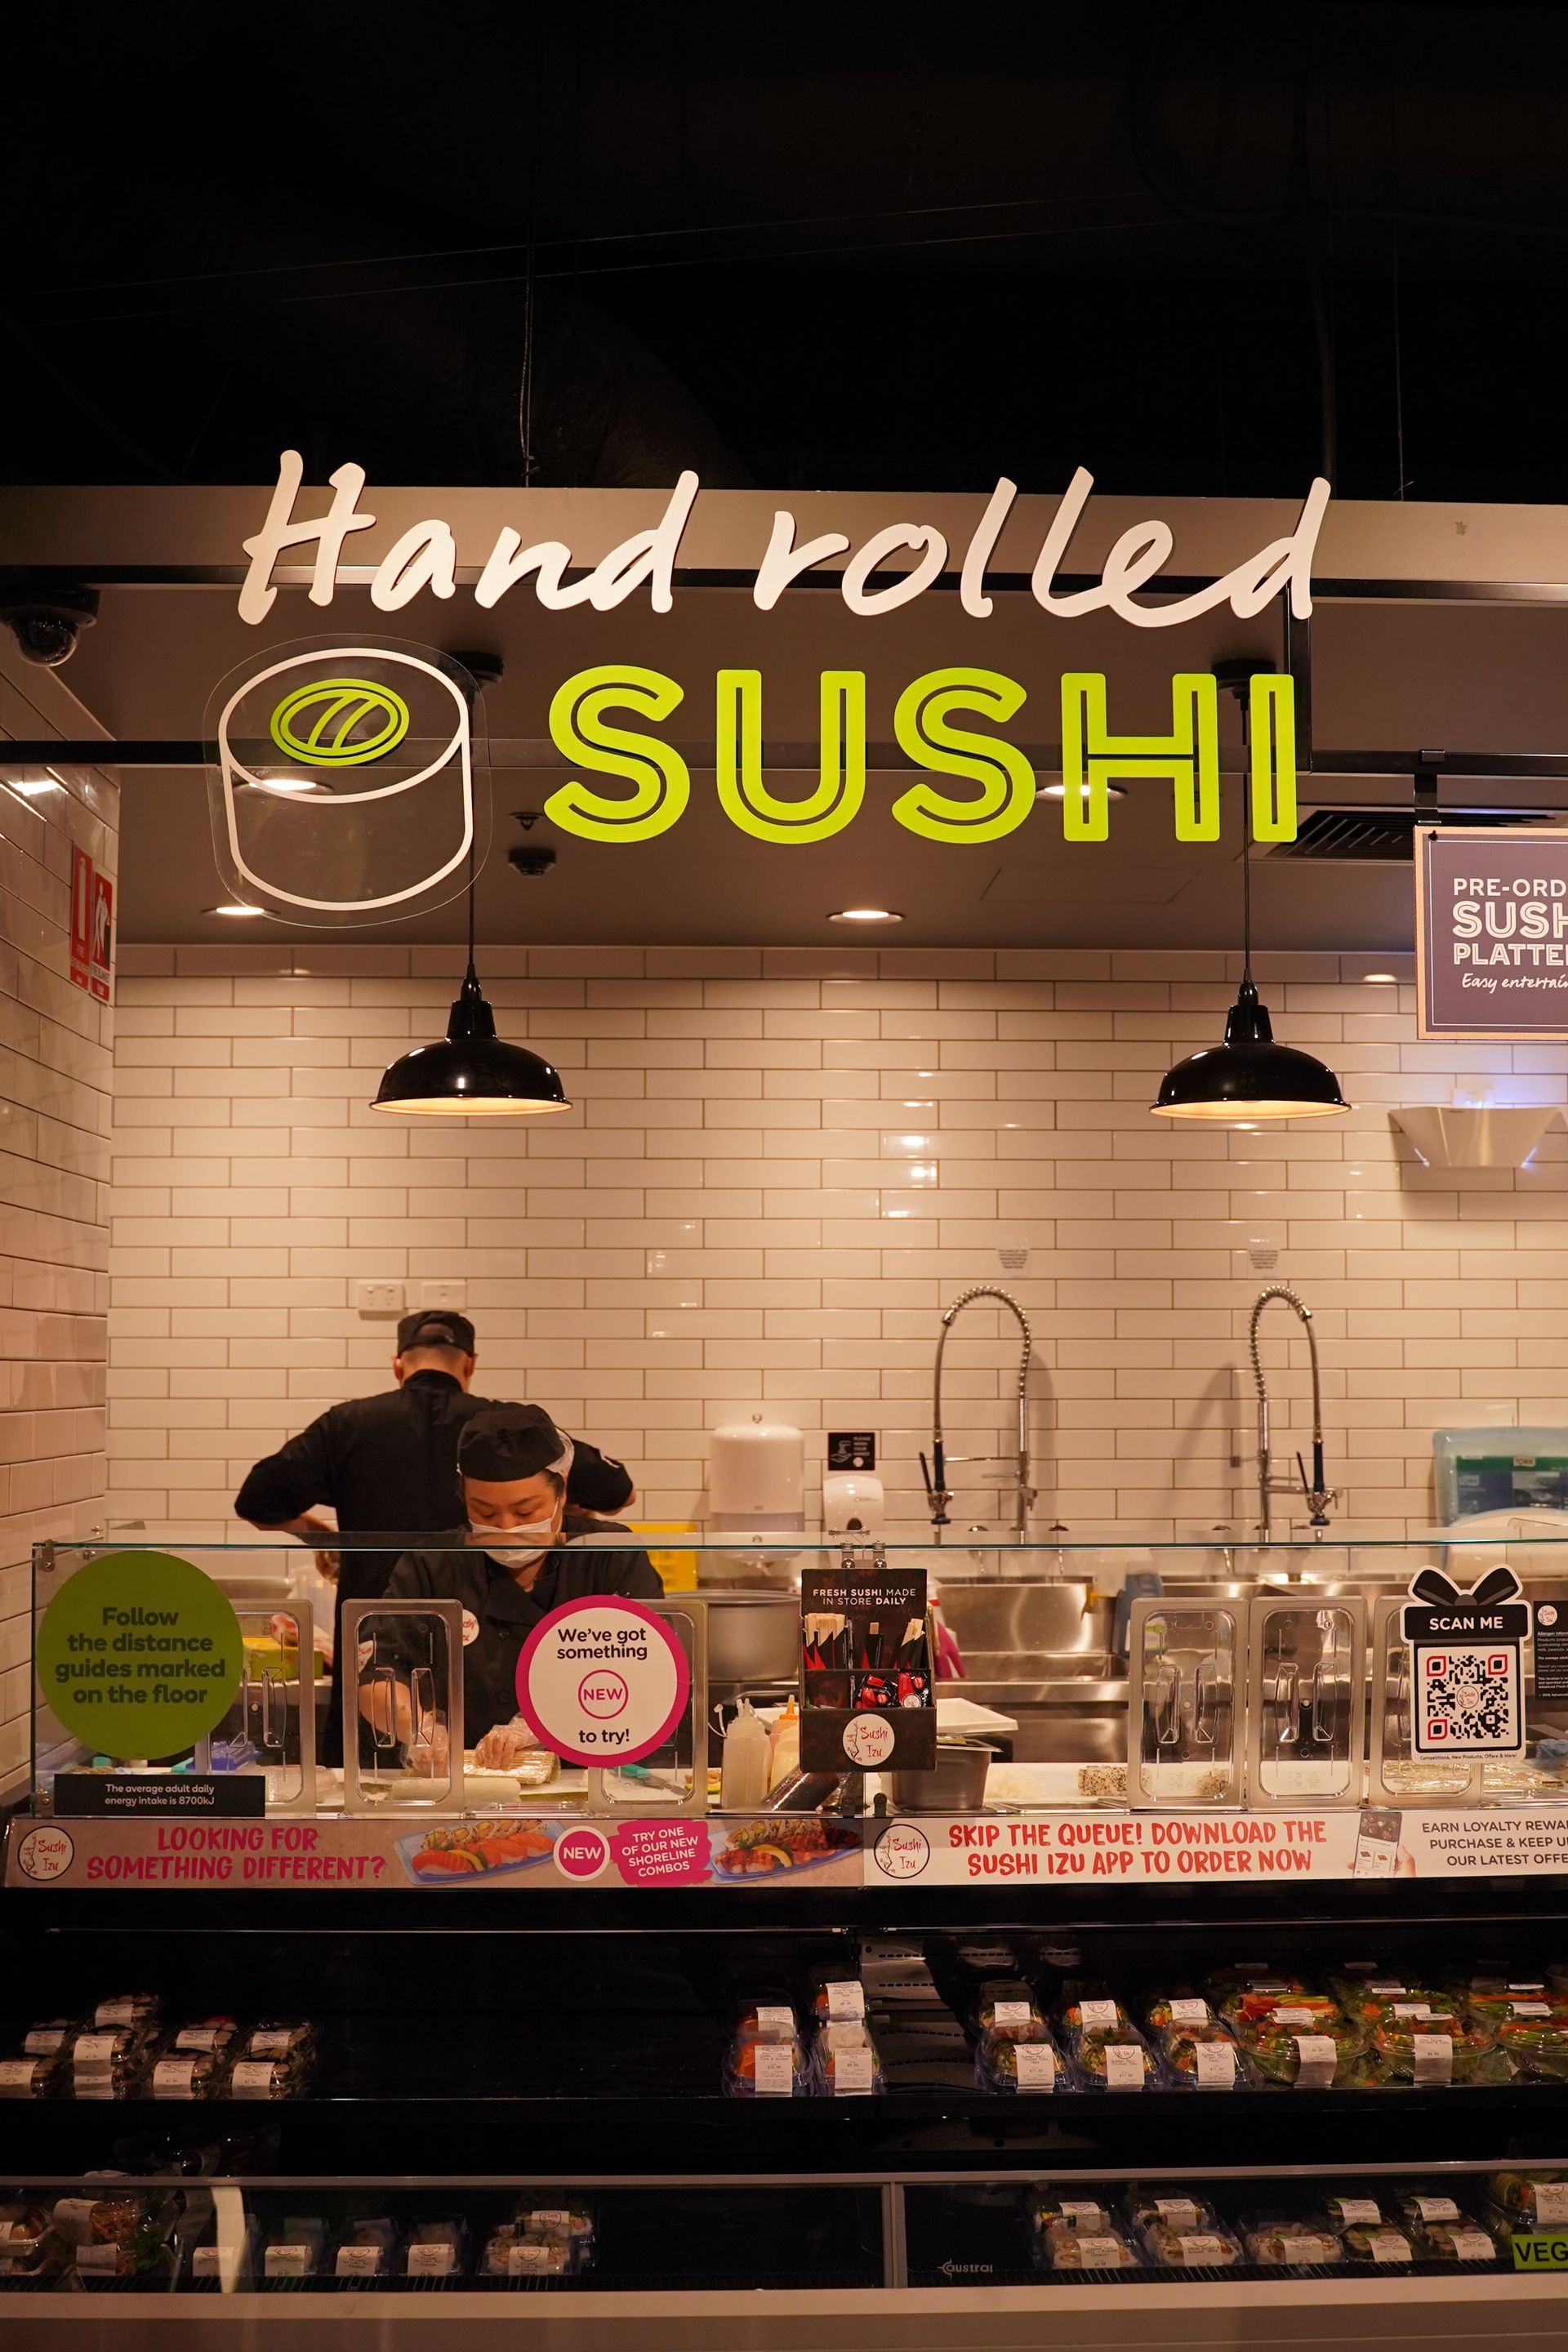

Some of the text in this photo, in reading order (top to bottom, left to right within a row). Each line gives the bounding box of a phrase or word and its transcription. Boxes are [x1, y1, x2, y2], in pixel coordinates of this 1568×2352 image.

[238, 450, 1331, 628] Hand rolled
[544, 664, 1298, 844] SUSHI
[1453, 878, 1567, 897] PRE-ORD
[1453, 943, 1568, 966] PLATTE
[1462, 973, 1497, 994] Easy
[102, 1607, 179, 1626] Follow
[1429, 1616, 1503, 1630] SCAN ME
[67, 1633, 213, 1652] the distance
[557, 1628, 646, 1644] We've got
[557, 1644, 647, 1660] something
[55, 1659, 226, 1683] guides marked
[73, 1685, 208, 1703] on the floor
[583, 1688, 623, 1700] NEW
[579, 1729, 630, 1745] to try!
[860, 1727, 889, 1741] Sushi
[866, 1745, 882, 1758] Izu
[105, 1784, 214, 1795] The average adult daily
[105, 1798, 137, 1807] energy
[179, 1797, 214, 1805] 8700kJ
[633, 1826, 684, 1843] TRY ONE
[949, 1820, 1327, 1847] SKIP THE QUEUE! DOWNLOAD THE
[1422, 1820, 1568, 1833] EARN LOYALTY REWA
[38, 1839, 67, 1854] Sushi
[158, 1827, 318, 1852] LOOKING FOR
[621, 1835, 699, 1856] OF OUR NEW
[892, 1838, 922, 1853] Sushi
[1430, 1837, 1568, 1849] PURCHASE & KEEP U
[563, 1846, 601, 1861] NEW
[628, 1848, 696, 1868] SHORELINE
[968, 1848, 1312, 1876] SUSHI IZU APP TO ORDER NOW
[1447, 1854, 1568, 1866] OUR LATEST OFFE
[87, 1855, 386, 1879] SOMETHING DIFFERENT?
[637, 1862, 690, 1877] COMBOS
[1515, 2241, 1568, 2262] VEG
